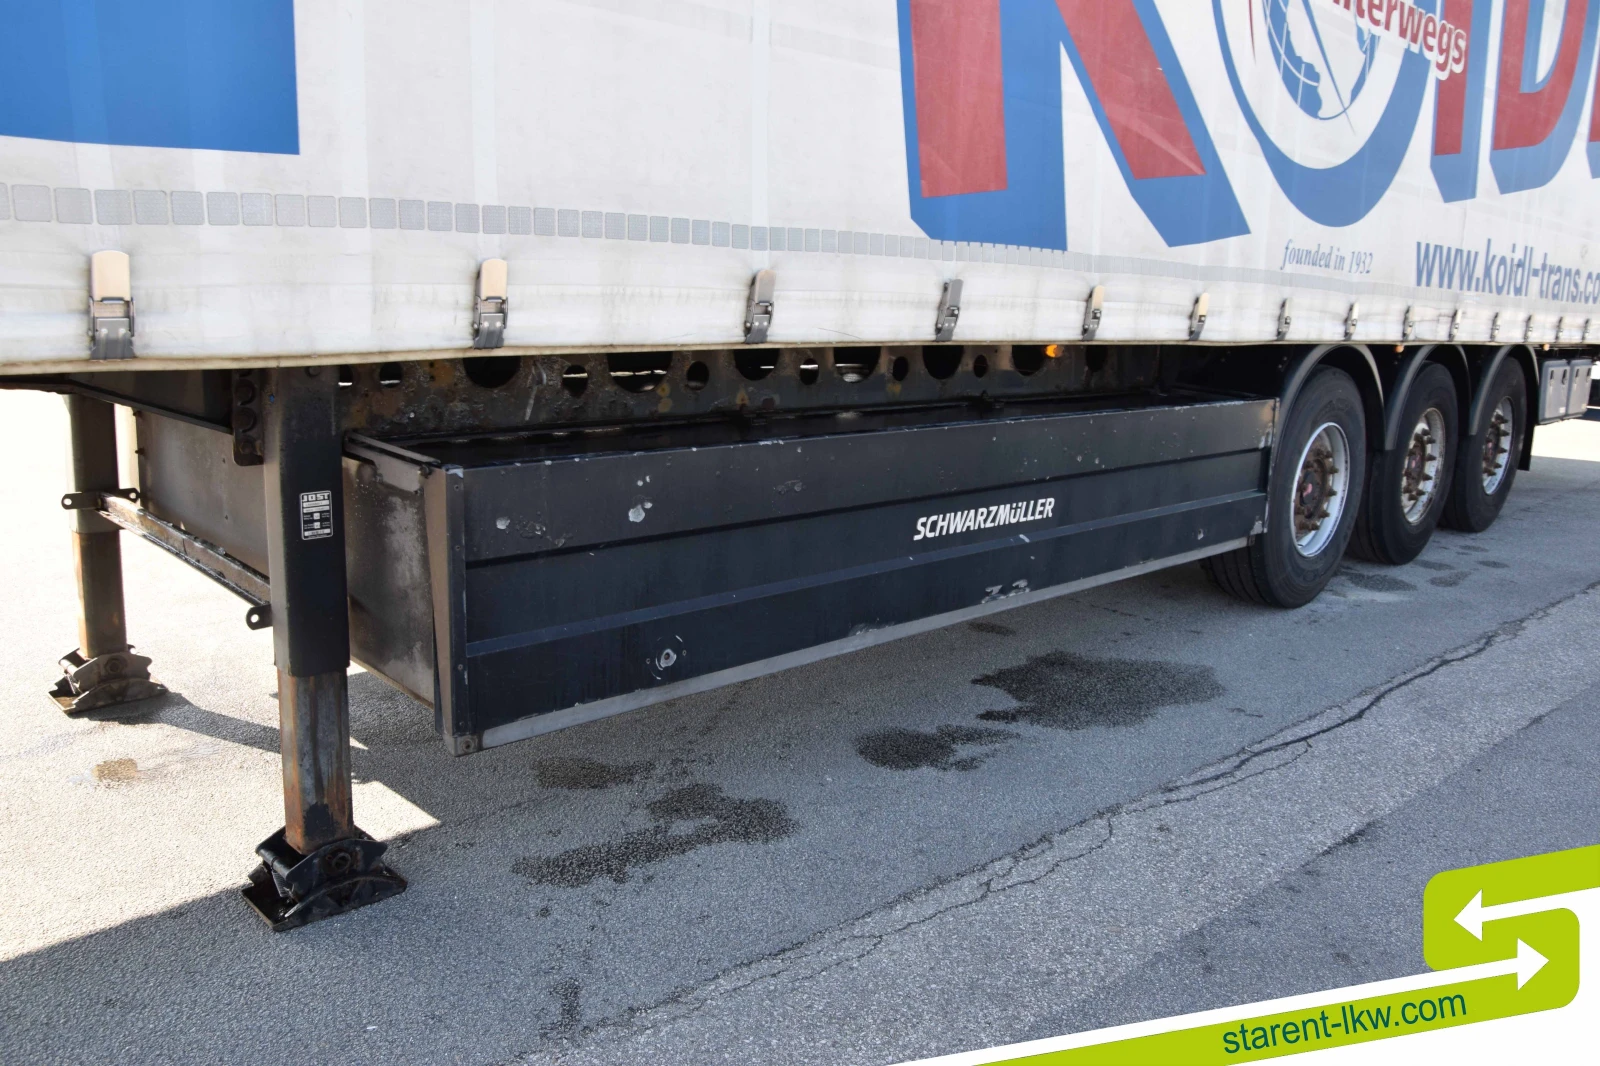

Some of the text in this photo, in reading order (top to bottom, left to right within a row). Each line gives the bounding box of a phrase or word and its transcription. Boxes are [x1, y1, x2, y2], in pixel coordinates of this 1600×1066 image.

[1280, 239, 1374, 274] founded in 1932
[302, 493, 330, 502] JOST
